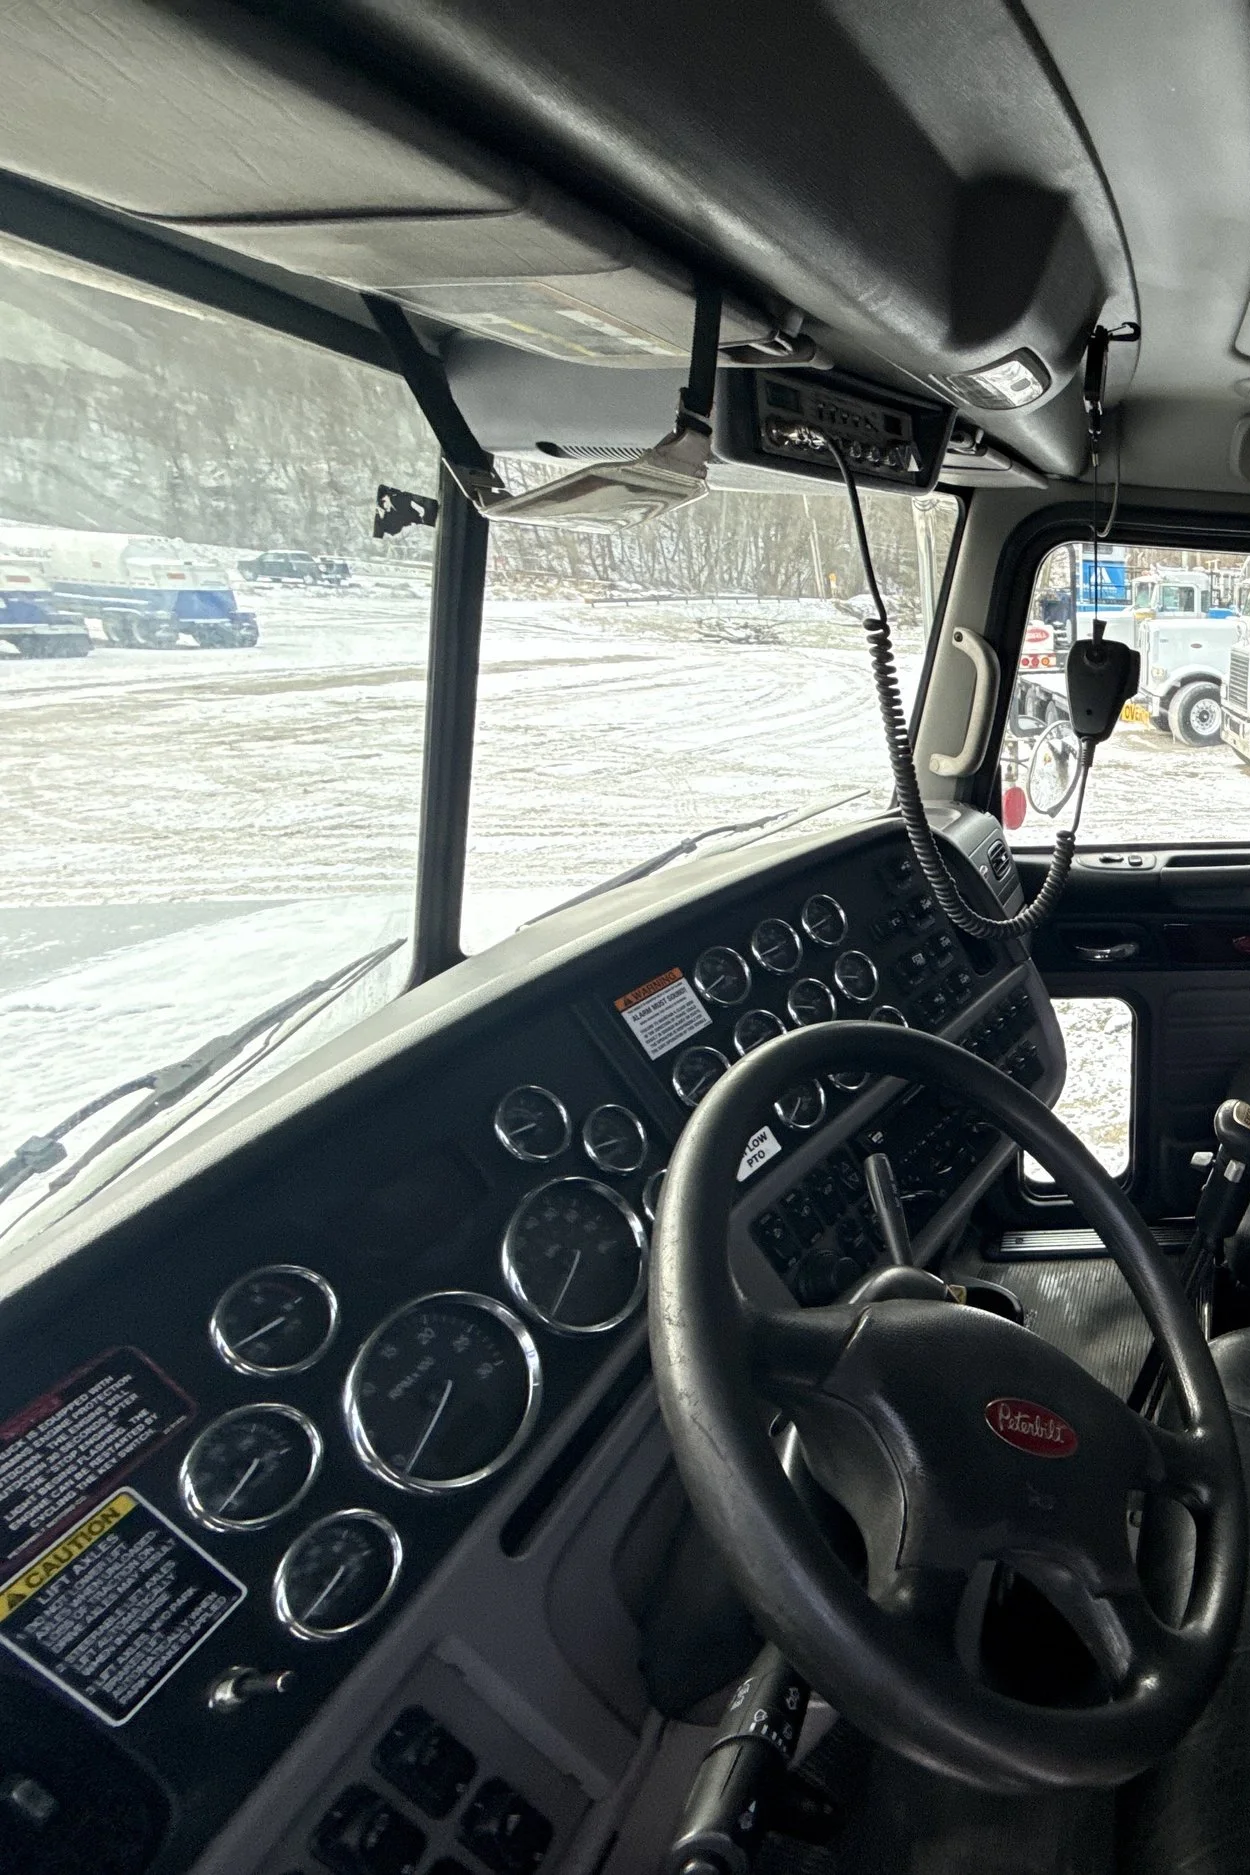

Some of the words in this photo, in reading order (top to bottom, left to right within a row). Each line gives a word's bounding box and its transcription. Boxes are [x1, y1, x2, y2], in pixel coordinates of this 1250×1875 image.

[631, 971, 677, 999] WARNING
[632, 1007, 653, 1022] ALARM
[652, 997, 667, 1012] MUST
[746, 1131, 767, 1152] LOW
[746, 1148, 766, 1168] PTO
[25, 1429, 39, 1440] IS
[36, 1392, 89, 1432] EQUIPPED
[87, 1375, 114, 1395] WITH
[31, 1417, 73, 1448] ENGINE
[71, 1373, 132, 1420] PROTECTION
[45, 1432, 69, 1450] THE
[67, 1405, 106, 1434] ENGINE
[103, 1388, 129, 1407] WILL
[997, 1402, 1065, 1444] Peterbilt
[0, 1461, 48, 1501] UTDOWN
[58, 1415, 108, 1453] SECONDS
[105, 1392, 139, 1418] AFTER
[2, 1494, 38, 1522] LIGHT
[36, 1463, 79, 1496] BEGINS
[127, 1407, 150, 1425] THE
[7, 1497, 52, 1531] ENGINE
[49, 1478, 75, 1498] CAN
[72, 1466, 91, 1480] BE
[86, 1422, 147, 1468] RESTARTED
[143, 1412, 159, 1425] BY
[21, 1474, 47, 1494] THE
[27, 1489, 78, 1528] CYCLING
[75, 1472, 98, 1491] THE
[95, 1457, 118, 1474] KEY
[21, 1505, 121, 1590] CAUTION
[35, 1574, 70, 1604] LIFT
[71, 1532, 120, 1576] AXLES
[42, 1594, 69, 1617] NOT
[66, 1560, 108, 1595] LOWER
[104, 1542, 128, 1563] LIFT
[86, 1558, 140, 1606] TRACTION
[136, 1544, 155, 1561] ON
[142, 1558, 177, 1589] AXLES
[33, 1605, 73, 1640] AXLES
[68, 1577, 104, 1608] WHEN
[82, 1591, 119, 1623] AXLES
[115, 1570, 141, 1593] MAY
[94, 1572, 177, 1649] AUTOMATICALLY
[168, 1584, 198, 1612] PARK
[109, 1617, 191, 1698] AUTOMATICALLY
[118, 1674, 149, 1705] PARK
[145, 1641, 181, 1676] BRAKE
[177, 1631, 191, 1644] IS
[187, 1594, 227, 1633] APPLIED
